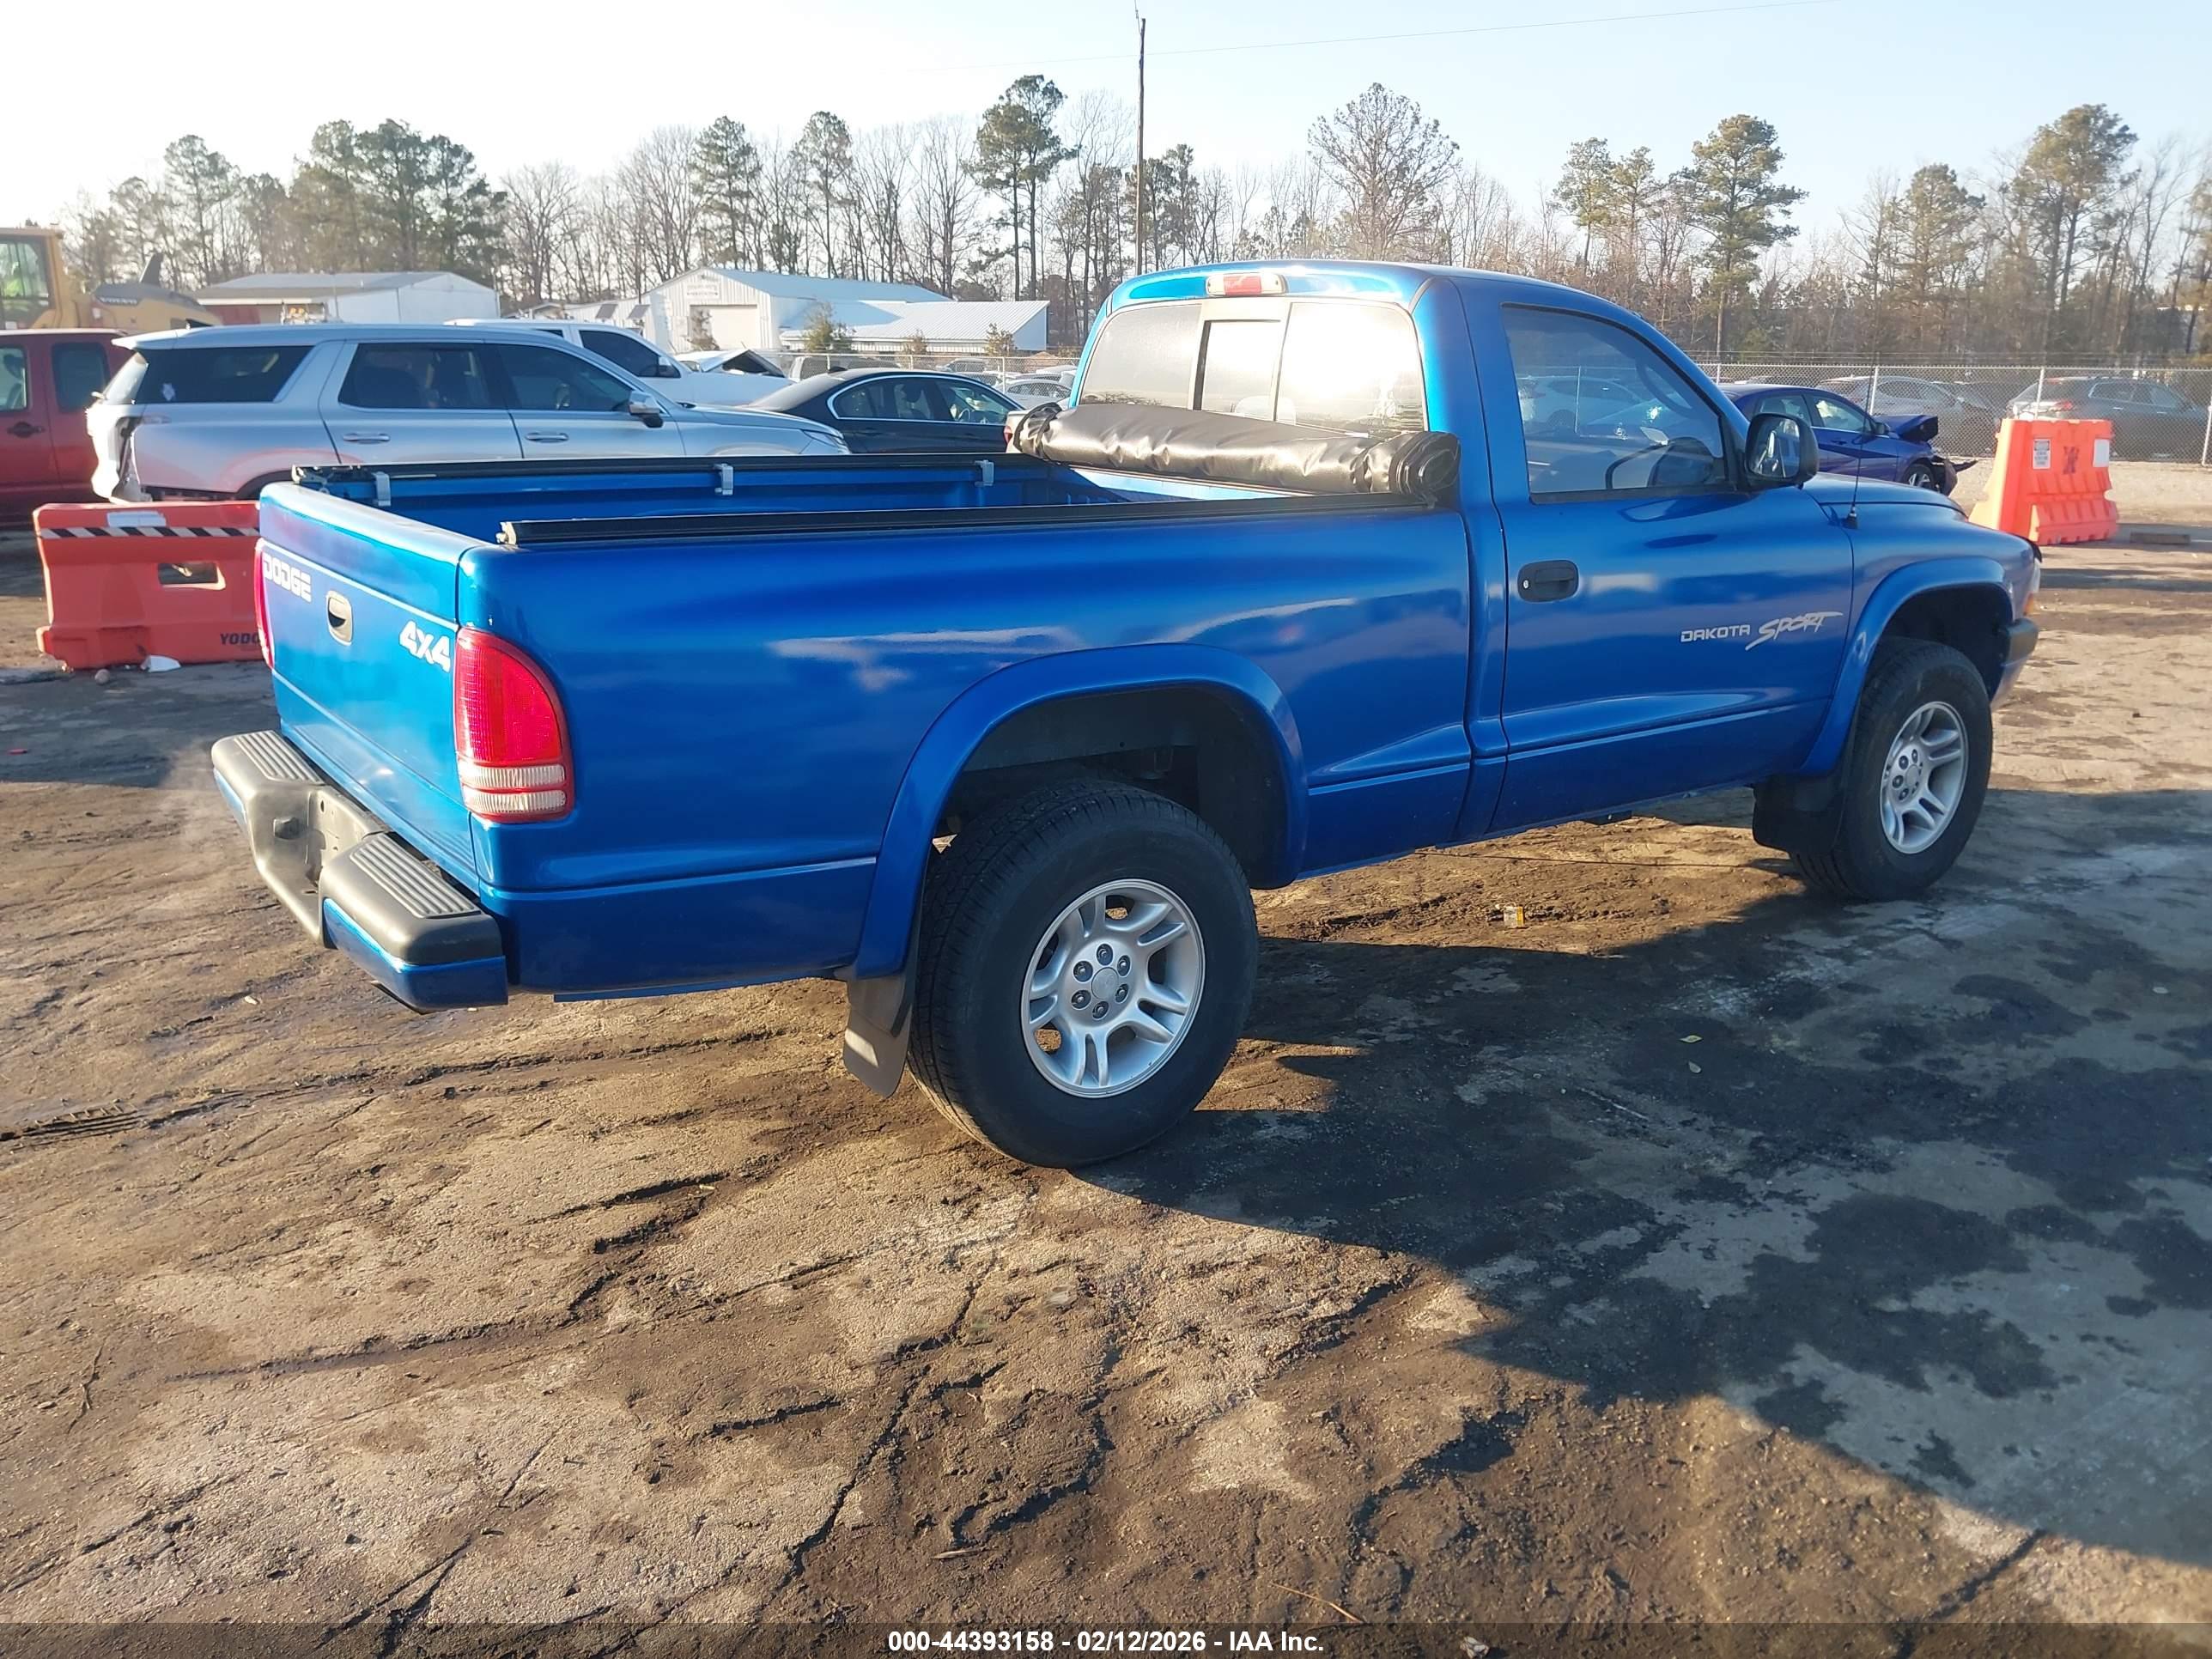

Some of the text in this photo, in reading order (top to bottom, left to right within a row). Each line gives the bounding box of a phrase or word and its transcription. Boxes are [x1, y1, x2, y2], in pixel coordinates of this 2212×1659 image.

[261, 551, 312, 603] DODGE
[1680, 611, 1844, 652] DAKOTA SPORT
